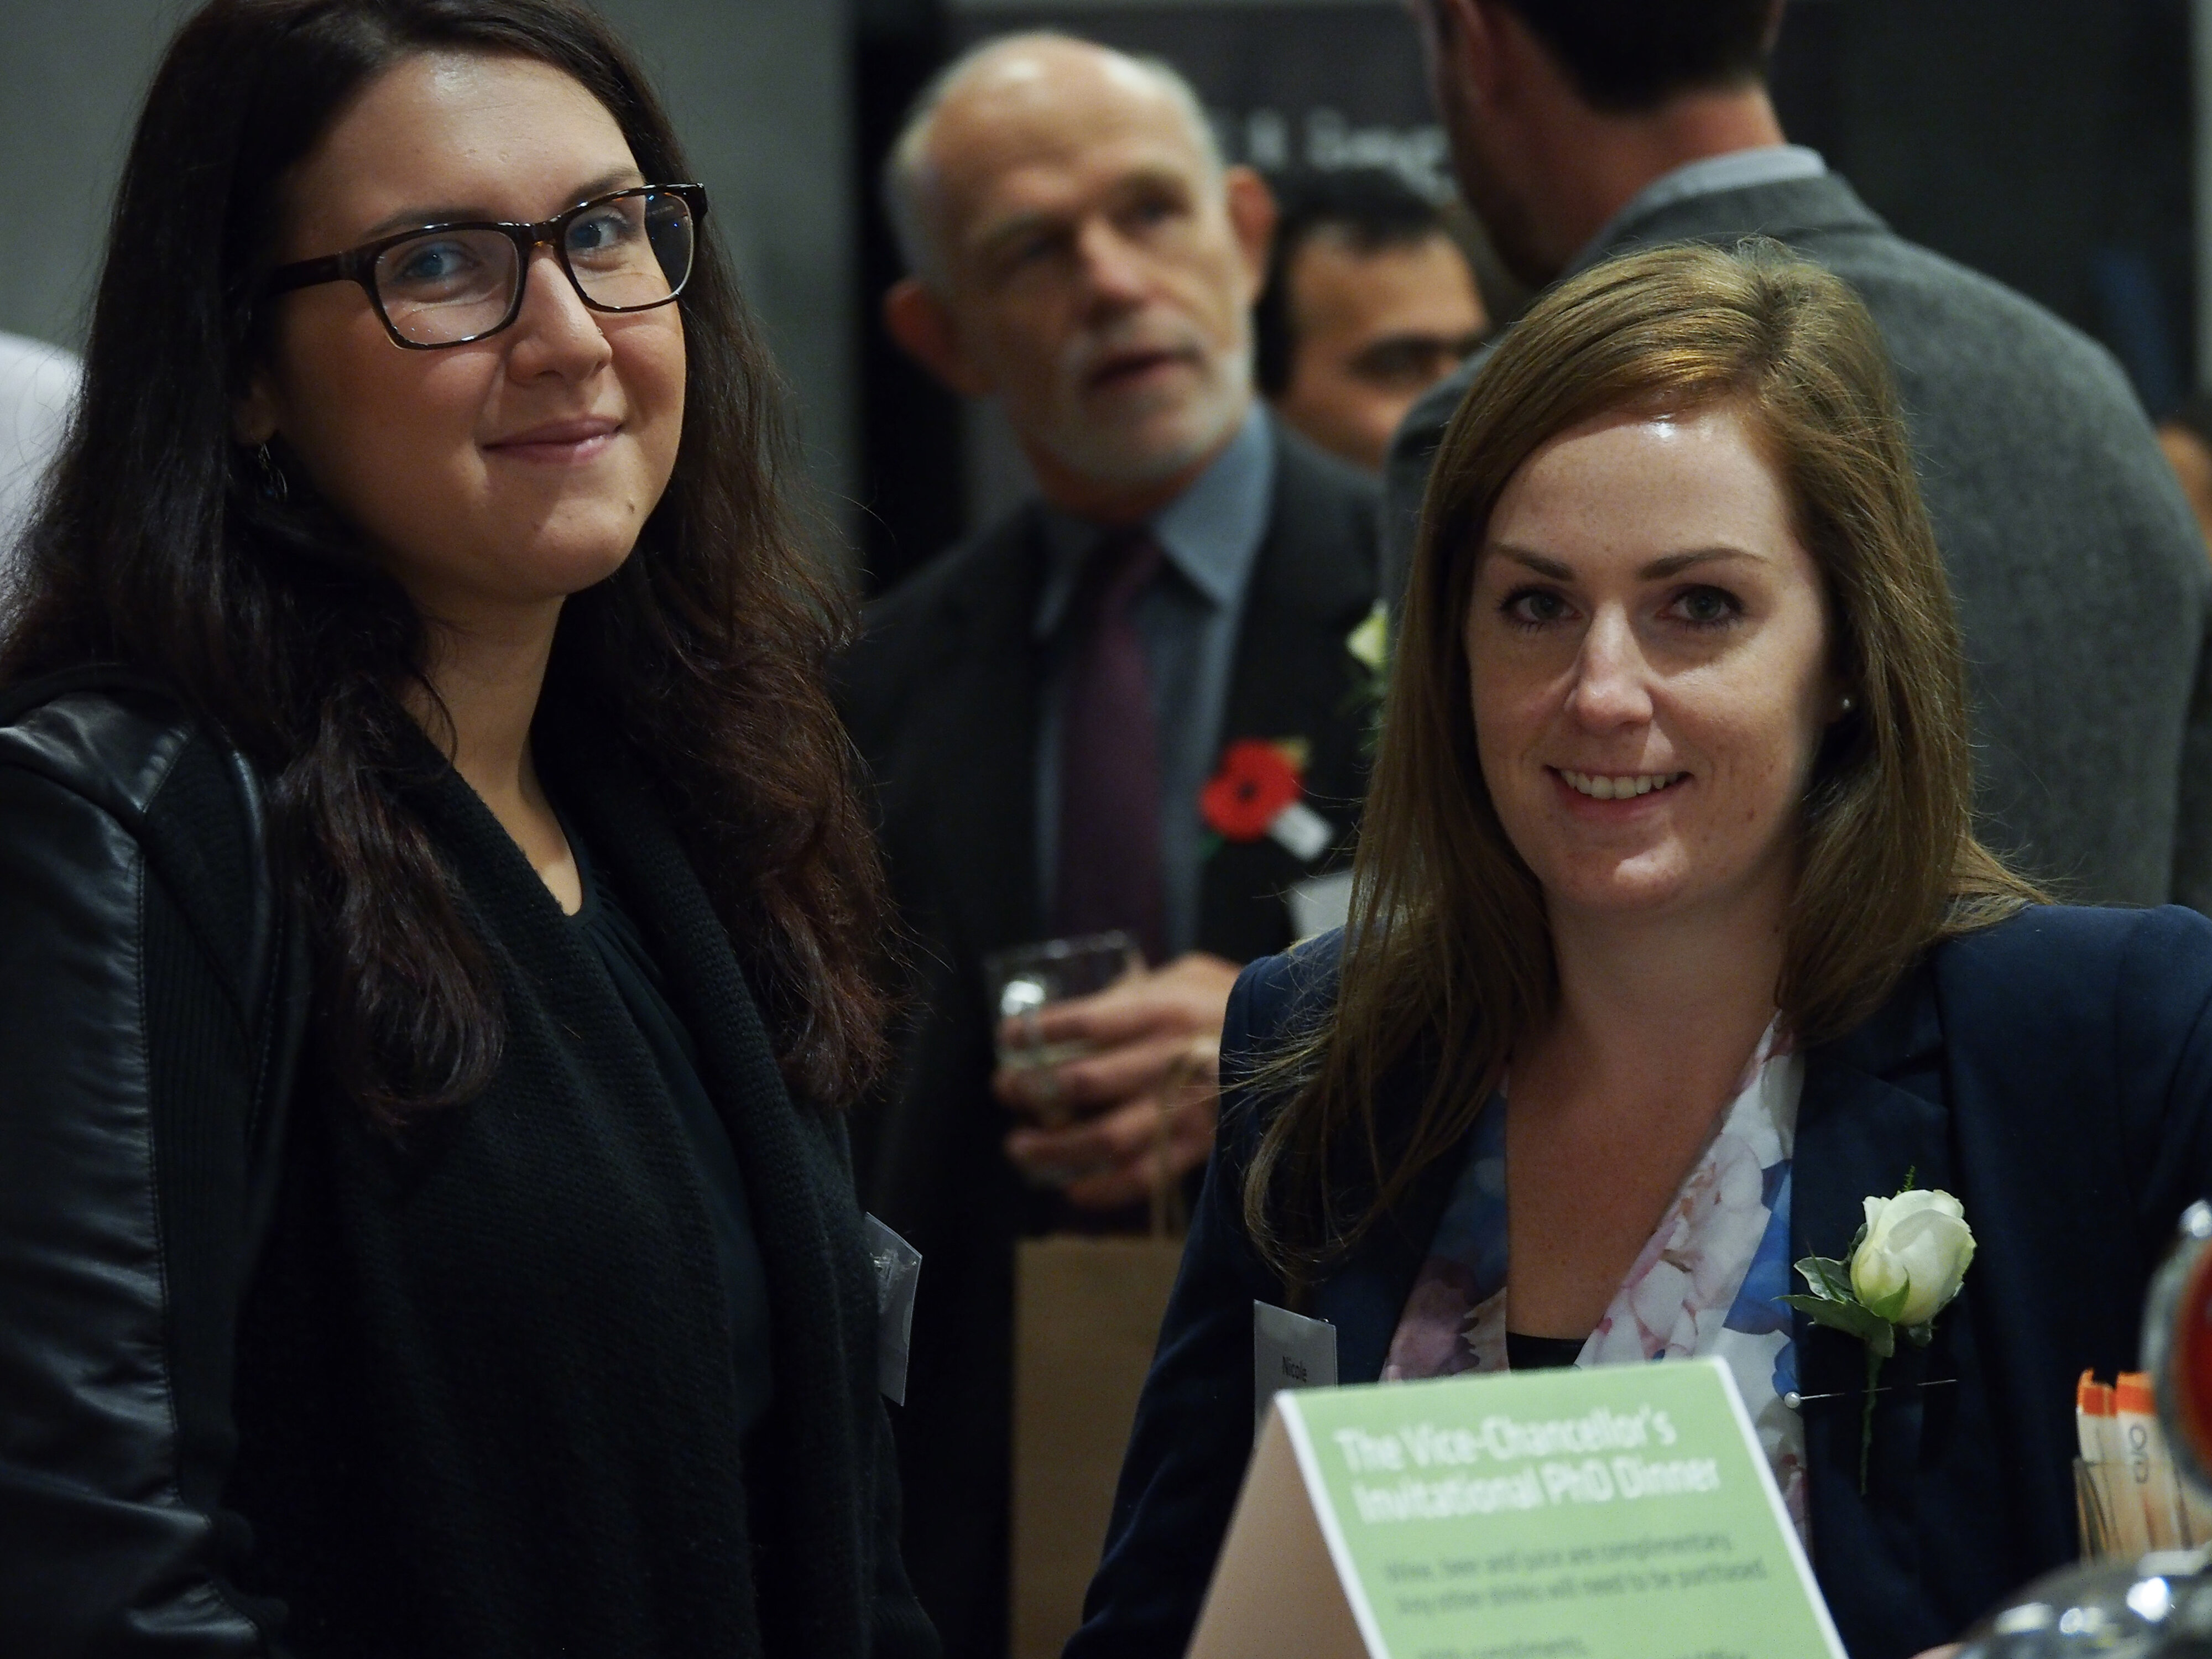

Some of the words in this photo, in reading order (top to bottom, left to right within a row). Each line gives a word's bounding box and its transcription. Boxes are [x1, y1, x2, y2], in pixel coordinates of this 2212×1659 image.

[1334, 1426, 1404, 1473] The
[1399, 1403, 1677, 1469] Vice-Chancellor's
[1352, 1464, 1544, 1525] Invitational
[1541, 1459, 1615, 1506] PhD
[1611, 1454, 1721, 1500] Dinner
